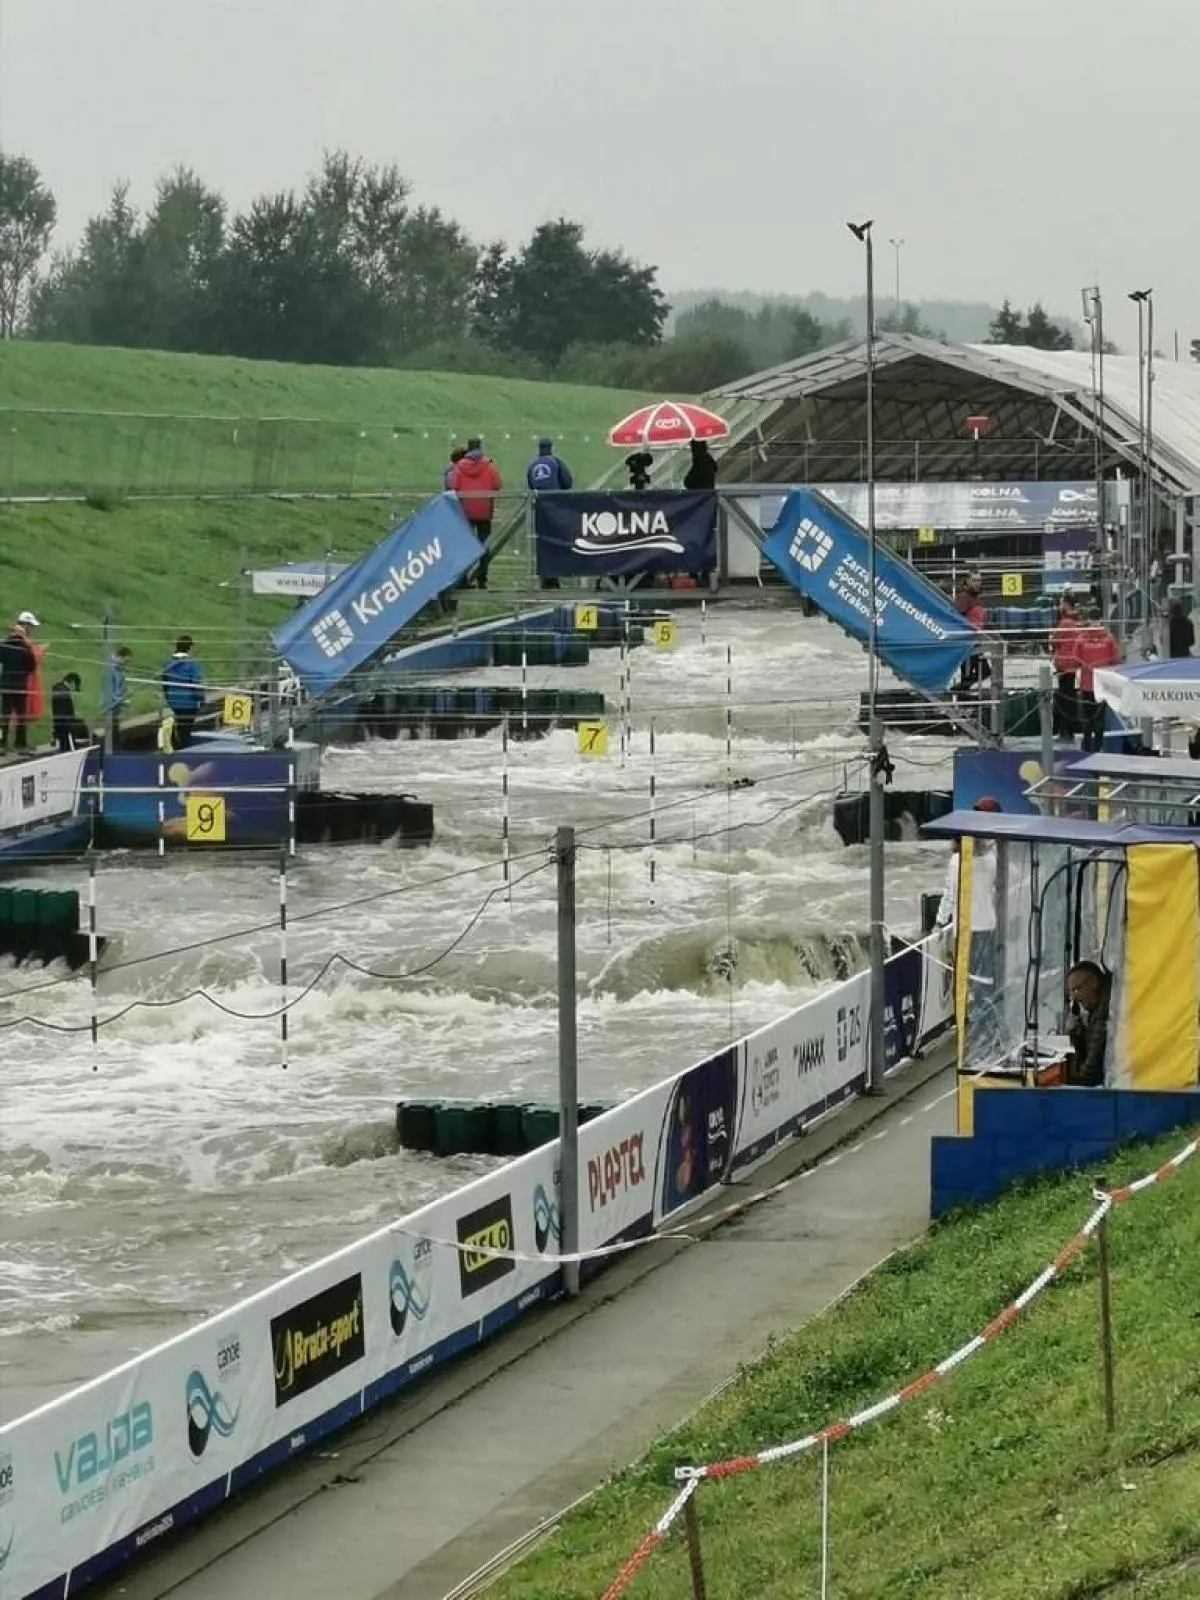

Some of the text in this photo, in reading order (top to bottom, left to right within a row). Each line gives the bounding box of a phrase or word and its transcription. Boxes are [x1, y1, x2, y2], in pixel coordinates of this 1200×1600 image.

[581, 510, 669, 537] KOLNA
[352, 537, 443, 625] Kraków
[1008, 577, 1017, 592] 3
[581, 610, 591, 625] 4
[660, 625, 671, 642] 5
[232, 699, 243, 721] 6
[586, 727, 600, 750] 7
[197, 803, 215, 833] 9
